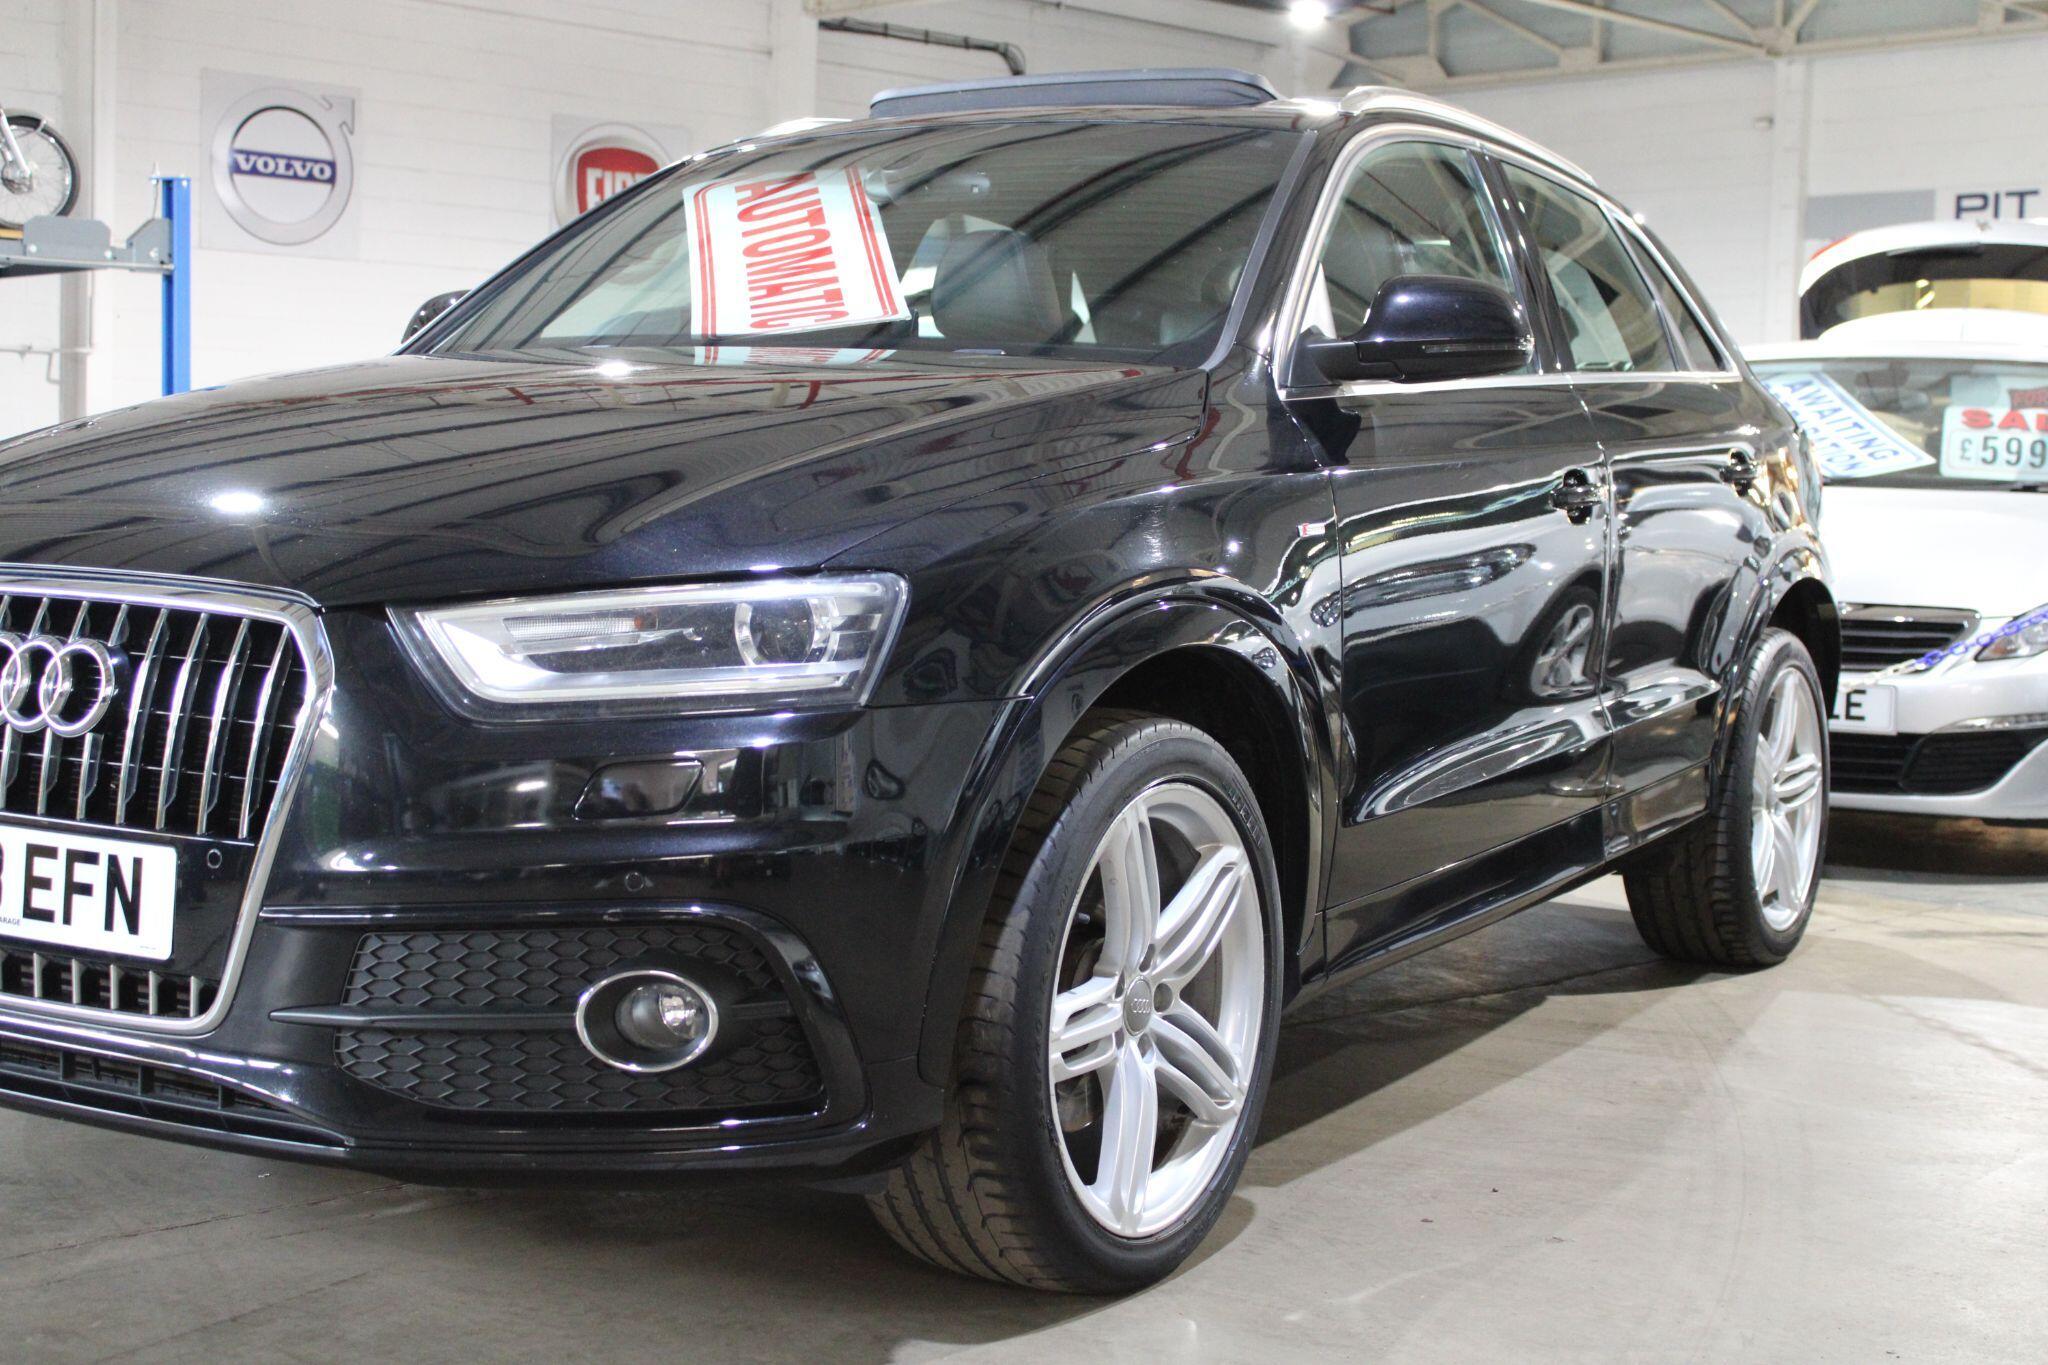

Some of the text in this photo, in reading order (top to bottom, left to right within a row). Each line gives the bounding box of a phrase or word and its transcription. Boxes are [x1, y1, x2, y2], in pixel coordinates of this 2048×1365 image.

[234, 154, 332, 181] VOLVO
[1955, 190, 2039, 219] PIT
[735, 171, 850, 329] AUTOMATIC
[1783, 379, 1900, 461] AWAITING
[1828, 689, 1867, 720] E
[23, 843, 143, 936] EFN
